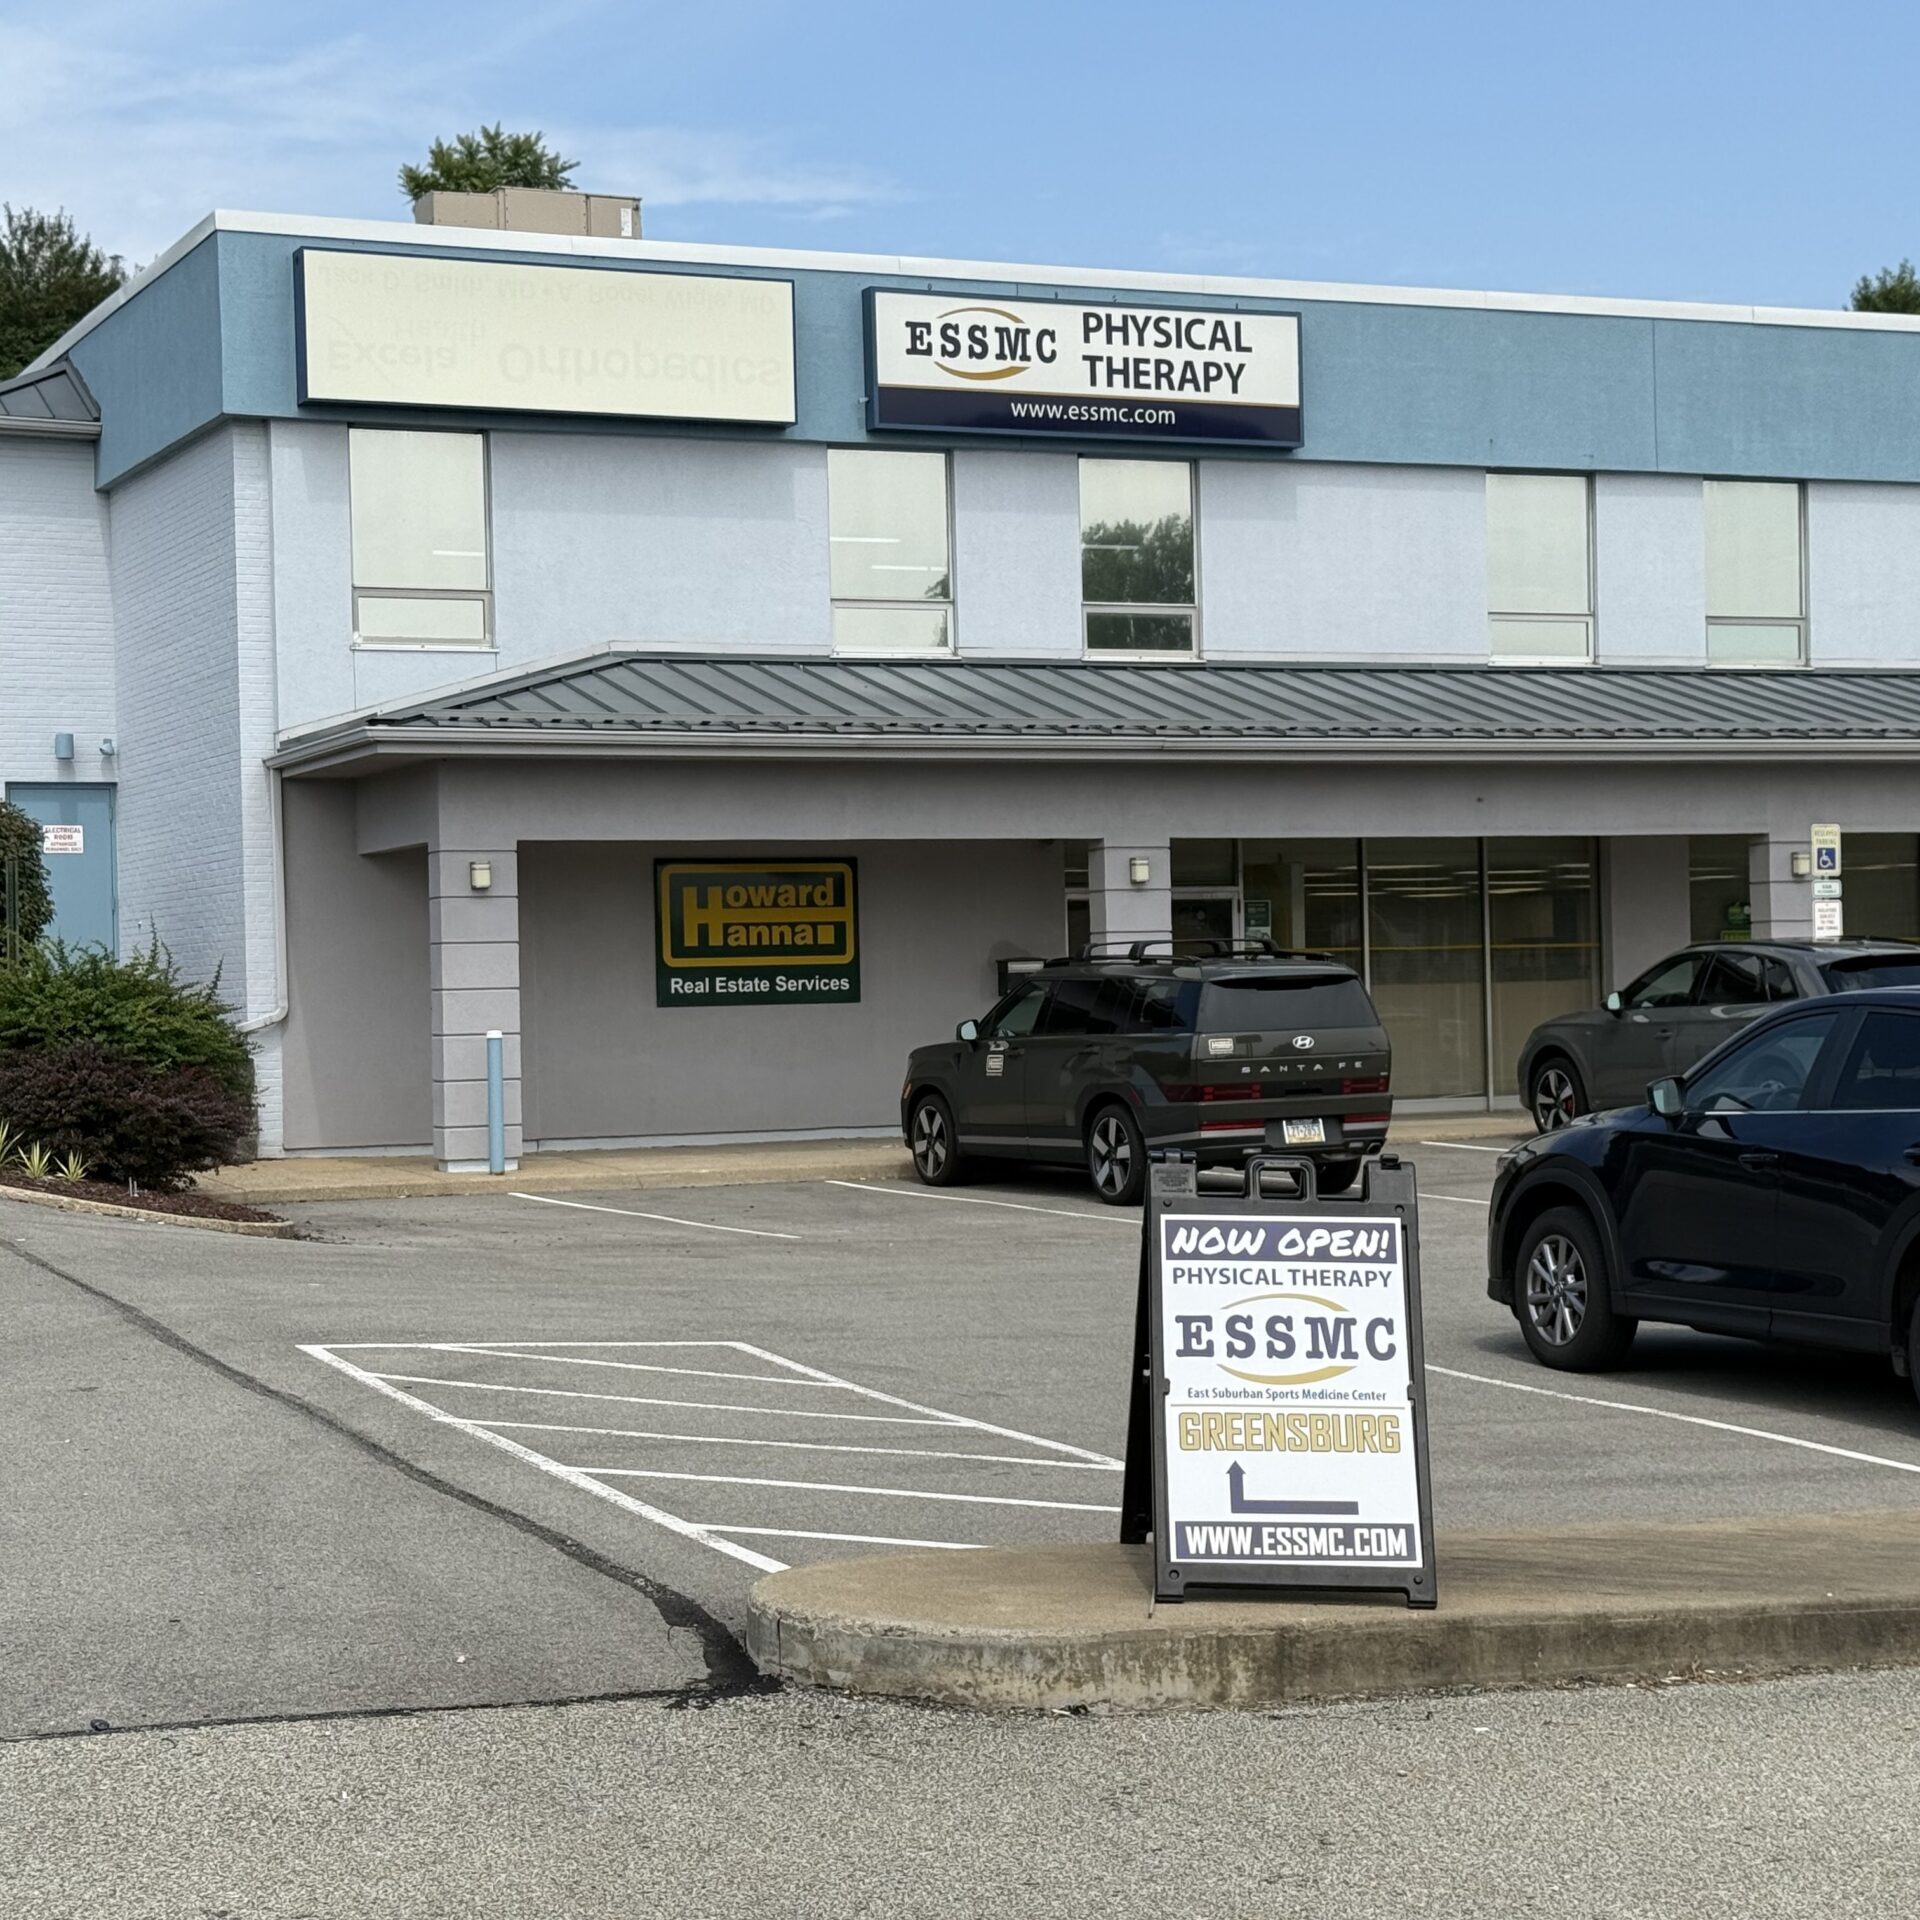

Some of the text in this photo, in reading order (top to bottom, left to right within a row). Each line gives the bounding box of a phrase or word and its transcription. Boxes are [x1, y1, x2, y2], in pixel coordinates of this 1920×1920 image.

[904, 319, 1058, 365] ESSMC
[1081, 311, 1254, 354] PHYSICAL
[1081, 354, 1247, 395] THERAPY
[1010, 401, 1177, 425] www.essmc.com
[682, 877, 834, 915] Howard
[682, 915, 814, 947] Hanna
[670, 975, 850, 994] Real Estate Services
[1241, 1061, 1363, 1074] SANTA FE
[1171, 1226, 1390, 1259] NOW OPEN!
[1172, 1267, 1392, 1288] PHYSICAL THERAPY
[1174, 1314, 1397, 1361] ESSMC
[1187, 1388, 1387, 1401] East Suburban Sports Medicine Center
[1178, 1411, 1401, 1454] GREENSBURG
[1184, 1525, 1408, 1557] WWW.ESSMC.COM
